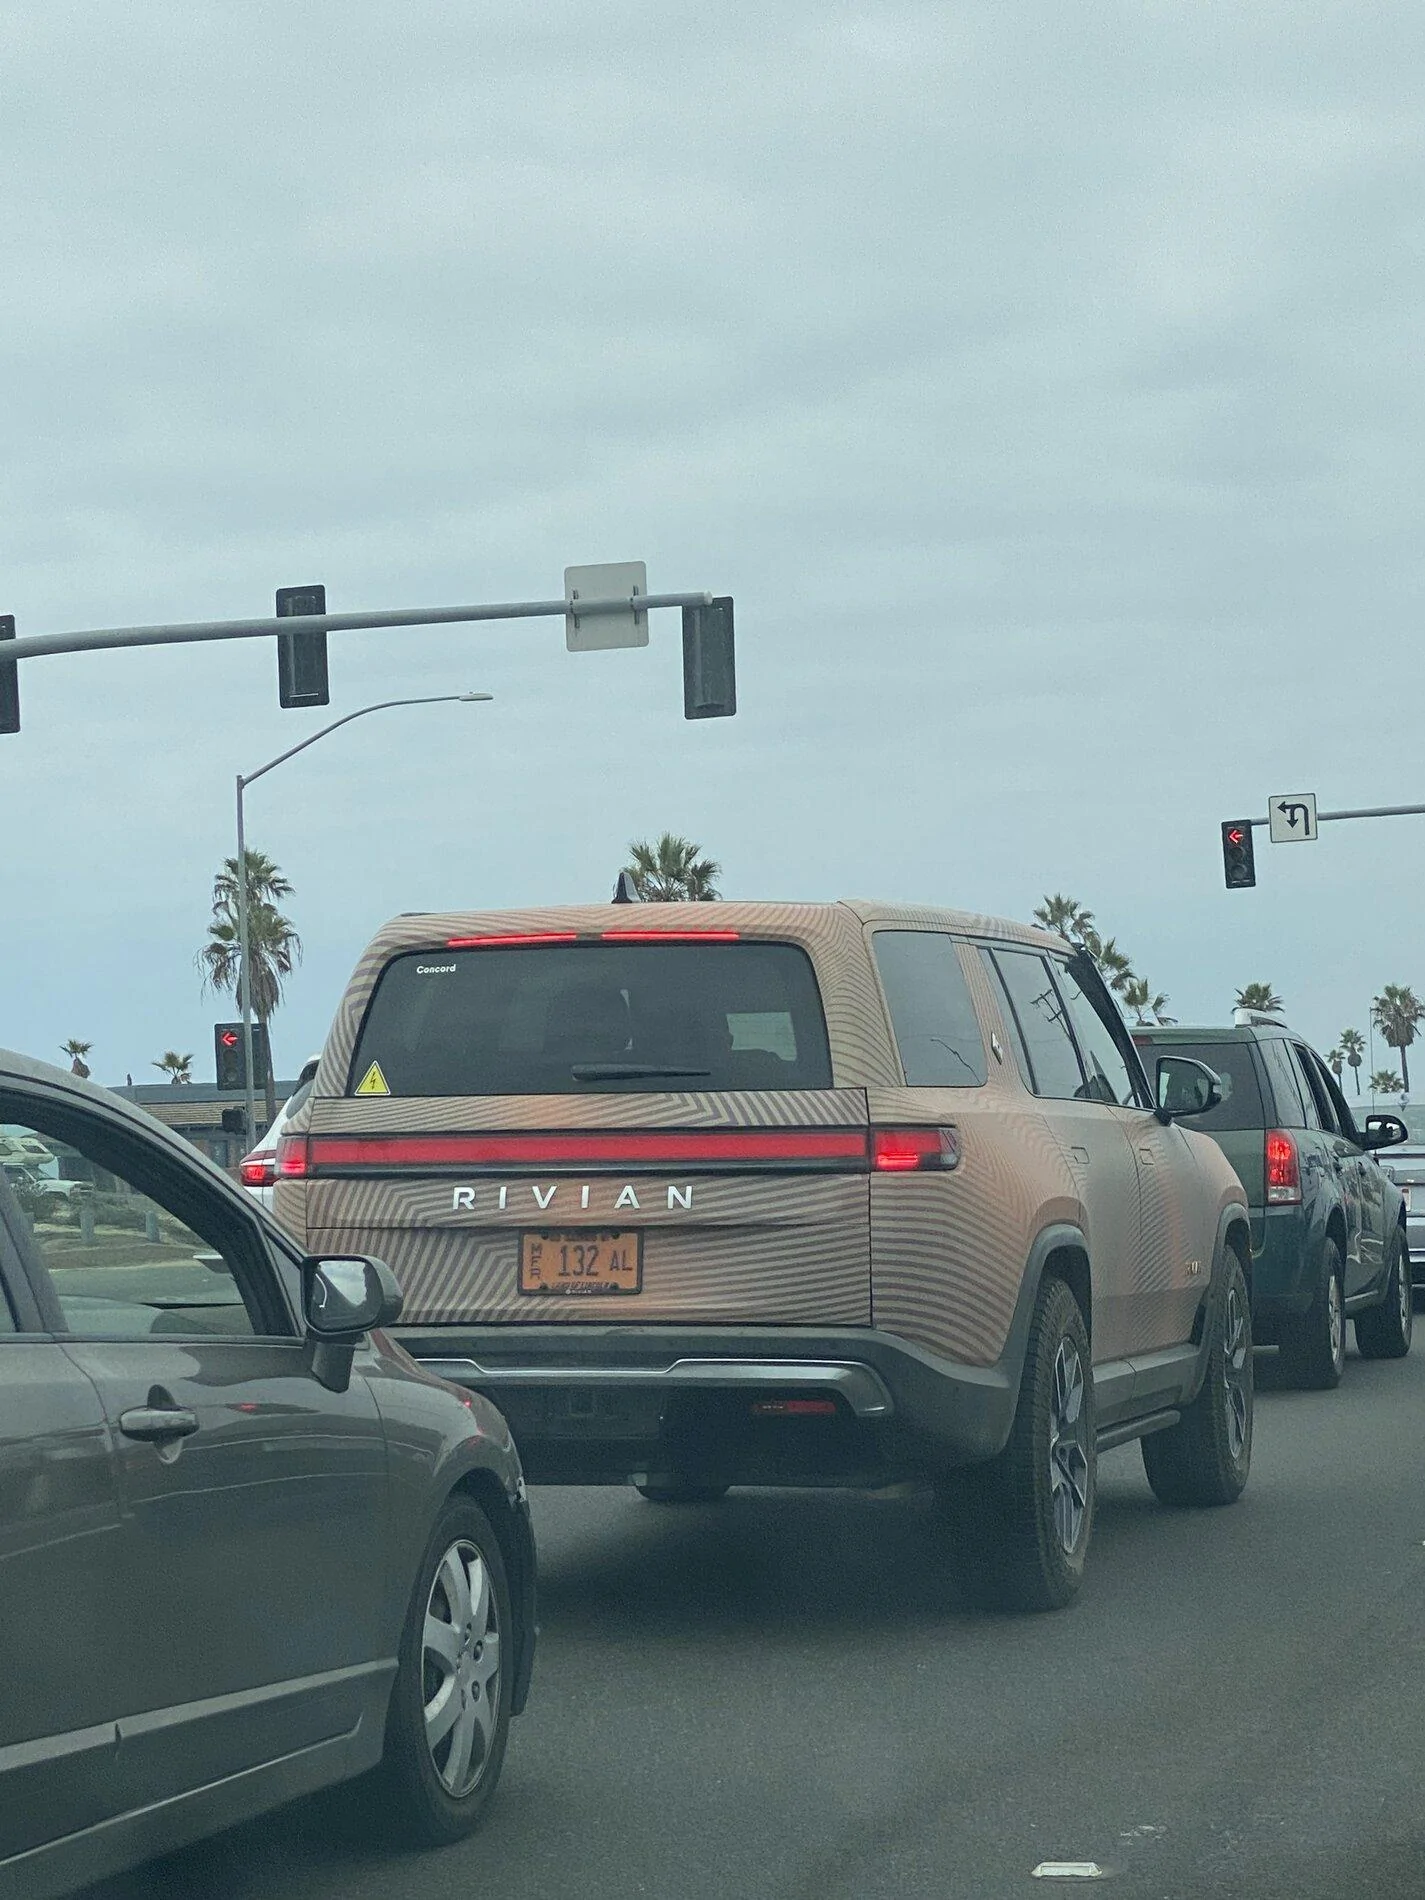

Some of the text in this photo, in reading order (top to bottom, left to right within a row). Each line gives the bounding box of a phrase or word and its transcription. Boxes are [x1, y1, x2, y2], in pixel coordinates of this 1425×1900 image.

[416, 963, 457, 975] Concord
[452, 1184, 694, 1211] RIVIAN
[558, 1244, 633, 1277] 132 AL
